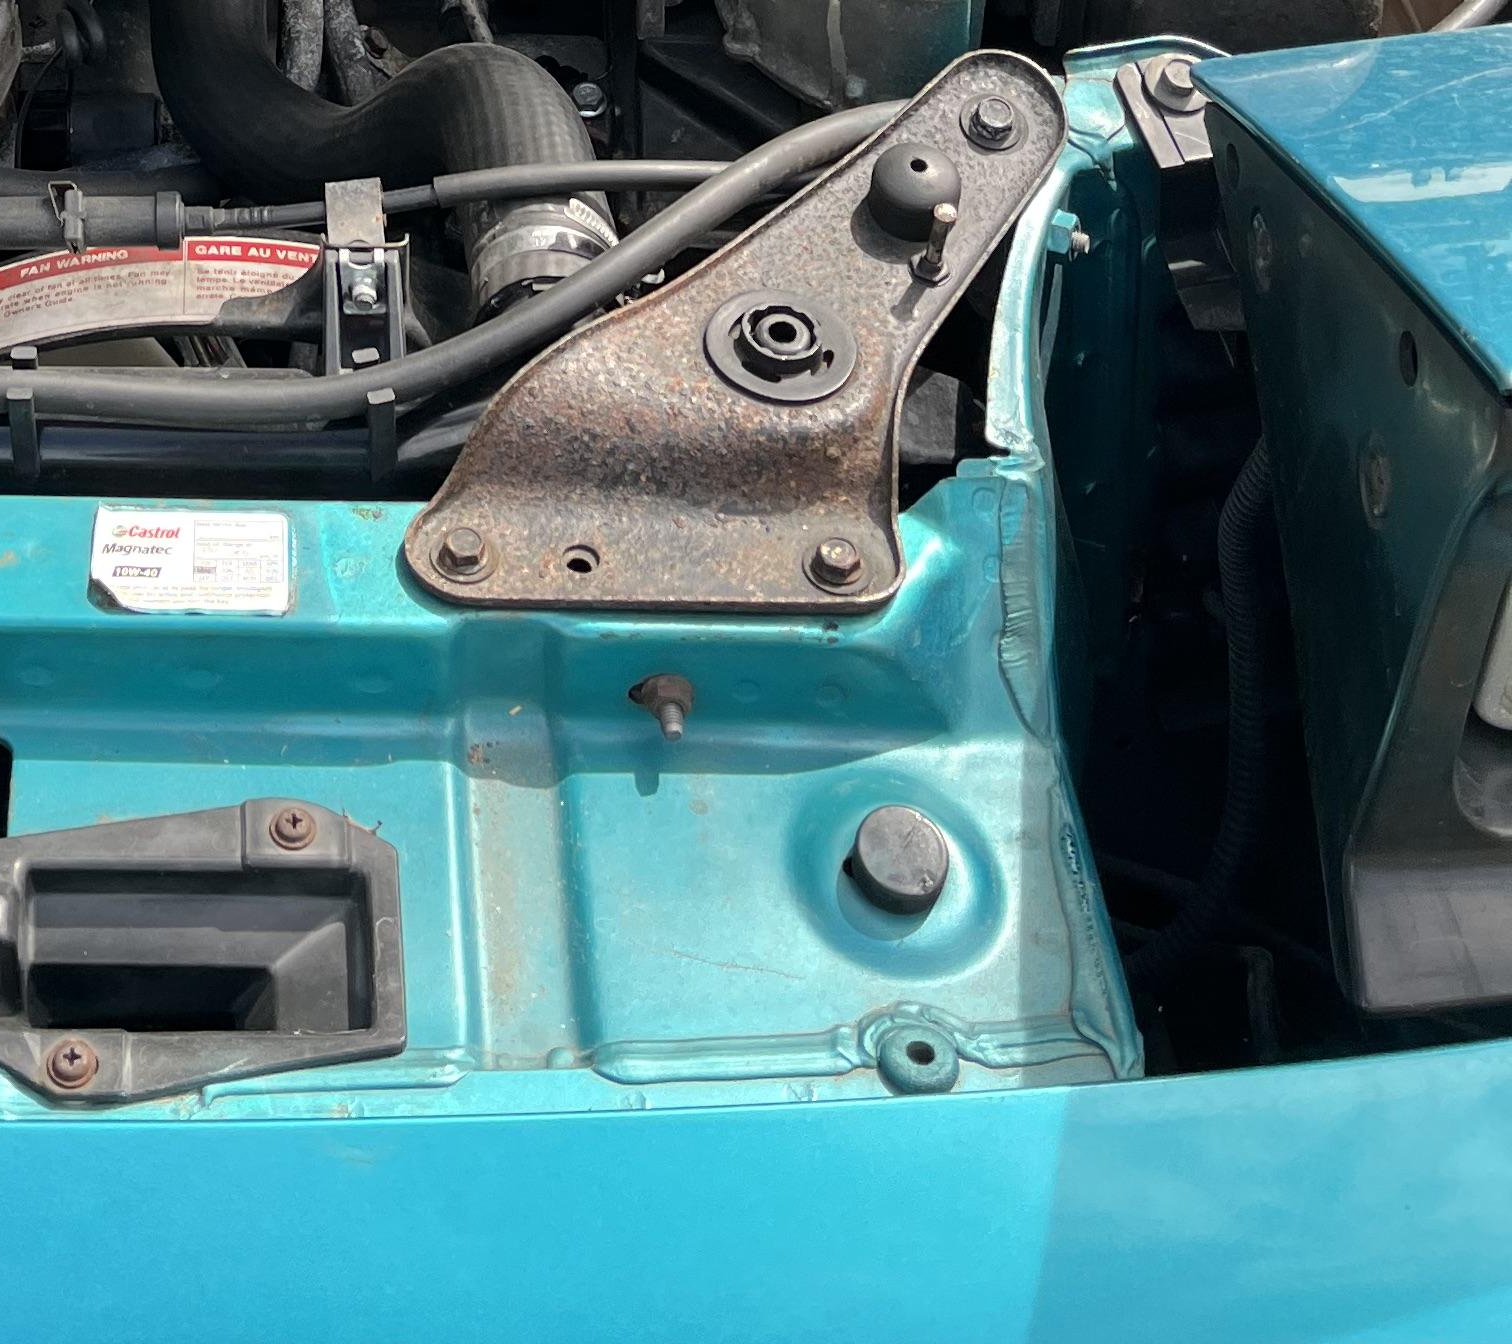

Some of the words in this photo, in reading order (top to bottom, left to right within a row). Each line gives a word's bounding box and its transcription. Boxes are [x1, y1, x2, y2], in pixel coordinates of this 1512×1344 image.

[19, 263, 51, 279] FAN
[56, 249, 129, 270] WARNING
[195, 245, 242, 256] GARE
[248, 246, 271, 258] AU
[276, 249, 319, 264] VENT
[8, 291, 30, 301] clear
[34, 285, 45, 294] of
[47, 282, 63, 290] fan
[66, 279, 75, 287] at
[23, 293, 51, 304] when
[54, 285, 92, 298] engine
[106, 281, 123, 289] not
[128, 525, 181, 539] Castrol
[102, 543, 173, 556] Magnatec
[114, 566, 158, 578] 10W-40
